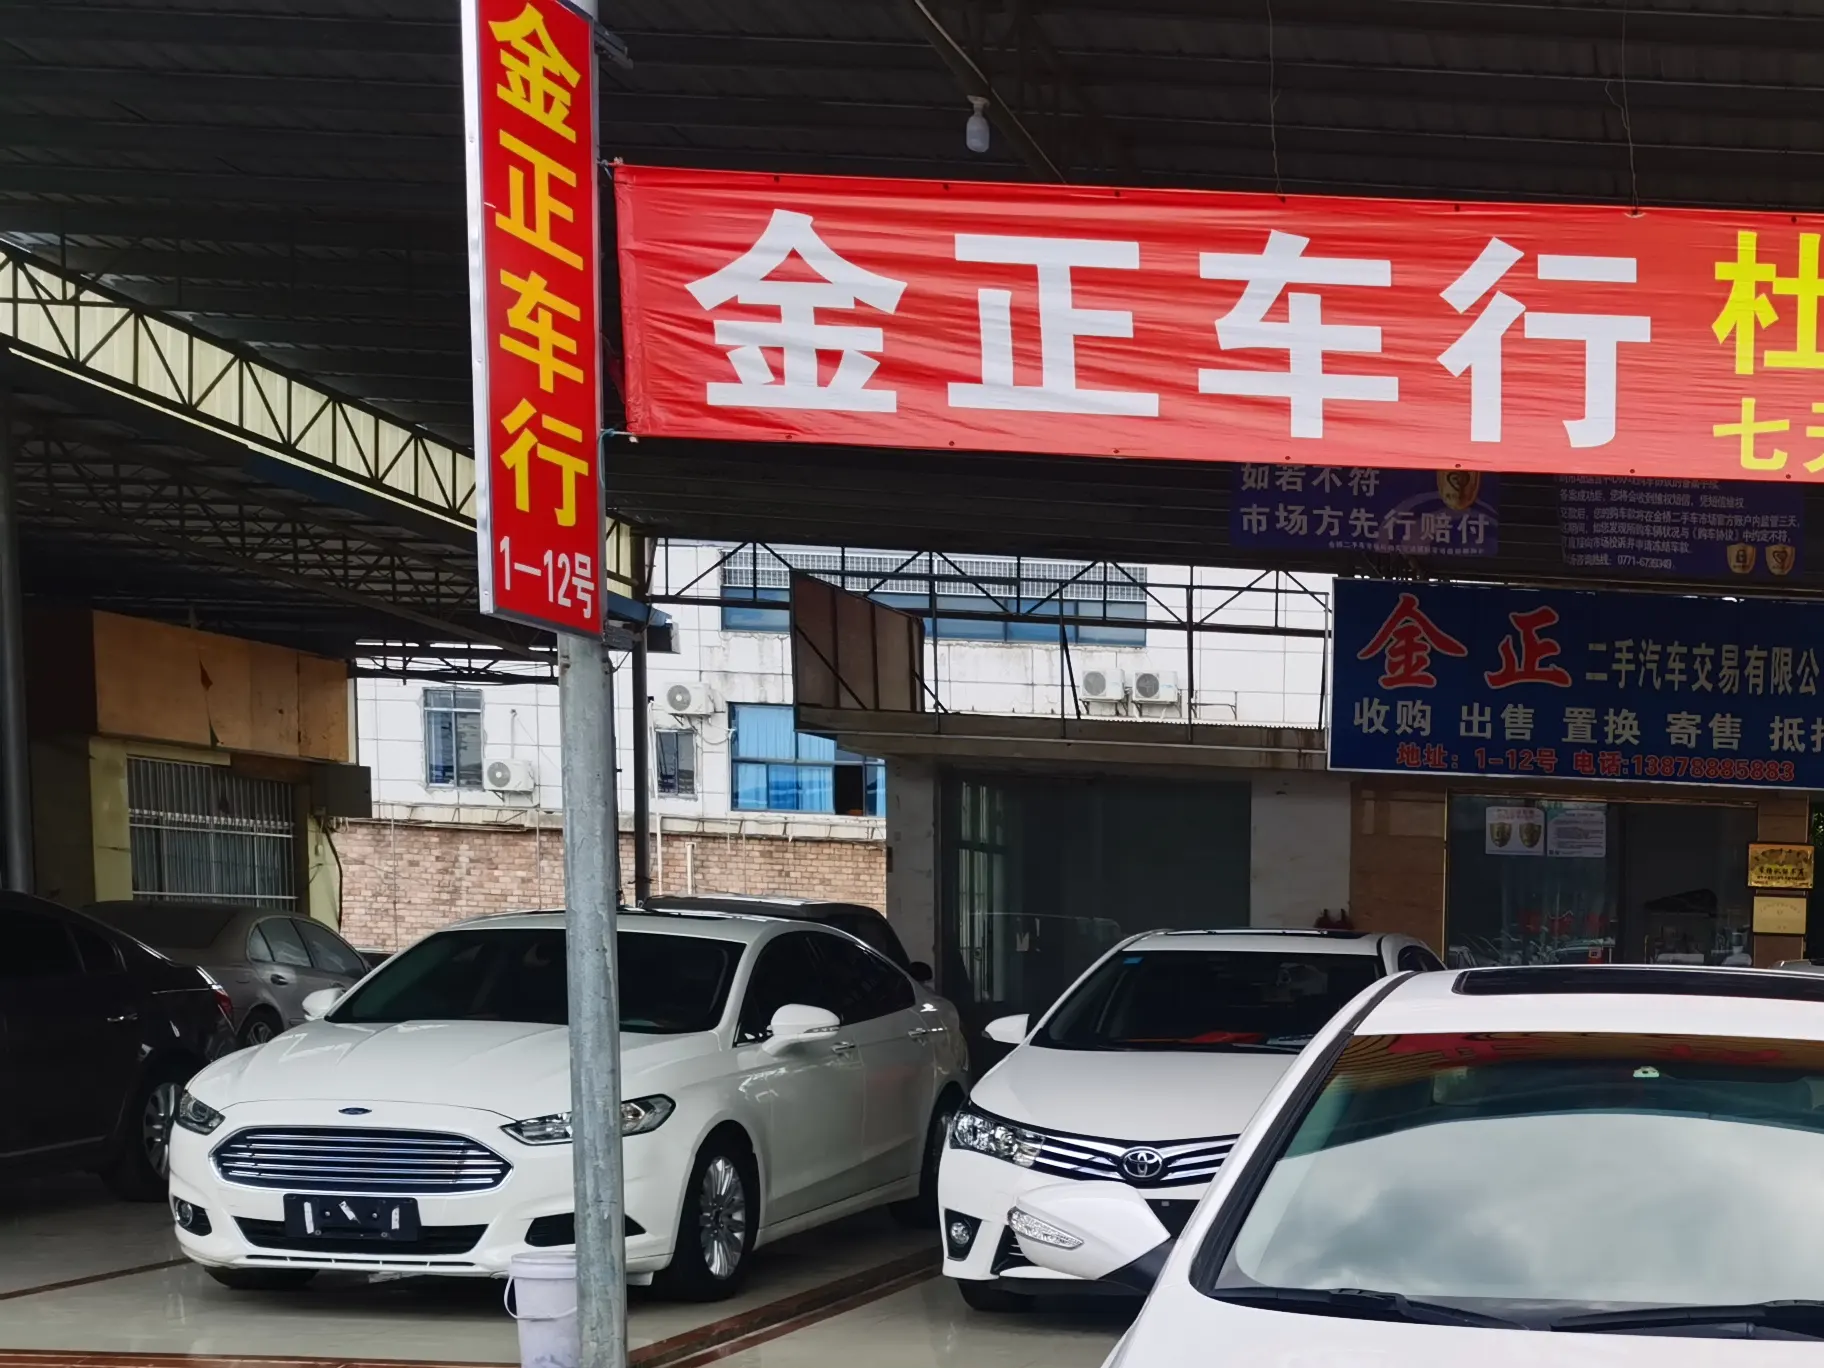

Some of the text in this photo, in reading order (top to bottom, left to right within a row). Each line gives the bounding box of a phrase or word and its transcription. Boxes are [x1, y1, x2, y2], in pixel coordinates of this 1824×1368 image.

[488, 2, 590, 527] 金正车行
[685, 208, 1652, 448] 金正车行
[1240, 503, 1490, 544] 市场方先行赔付
[1357, 591, 1573, 690] 金正
[1354, 696, 1432, 737] 收购
[1459, 702, 1536, 741] 出售
[1562, 706, 1641, 746] 置换
[1665, 709, 1743, 751] 寄售
